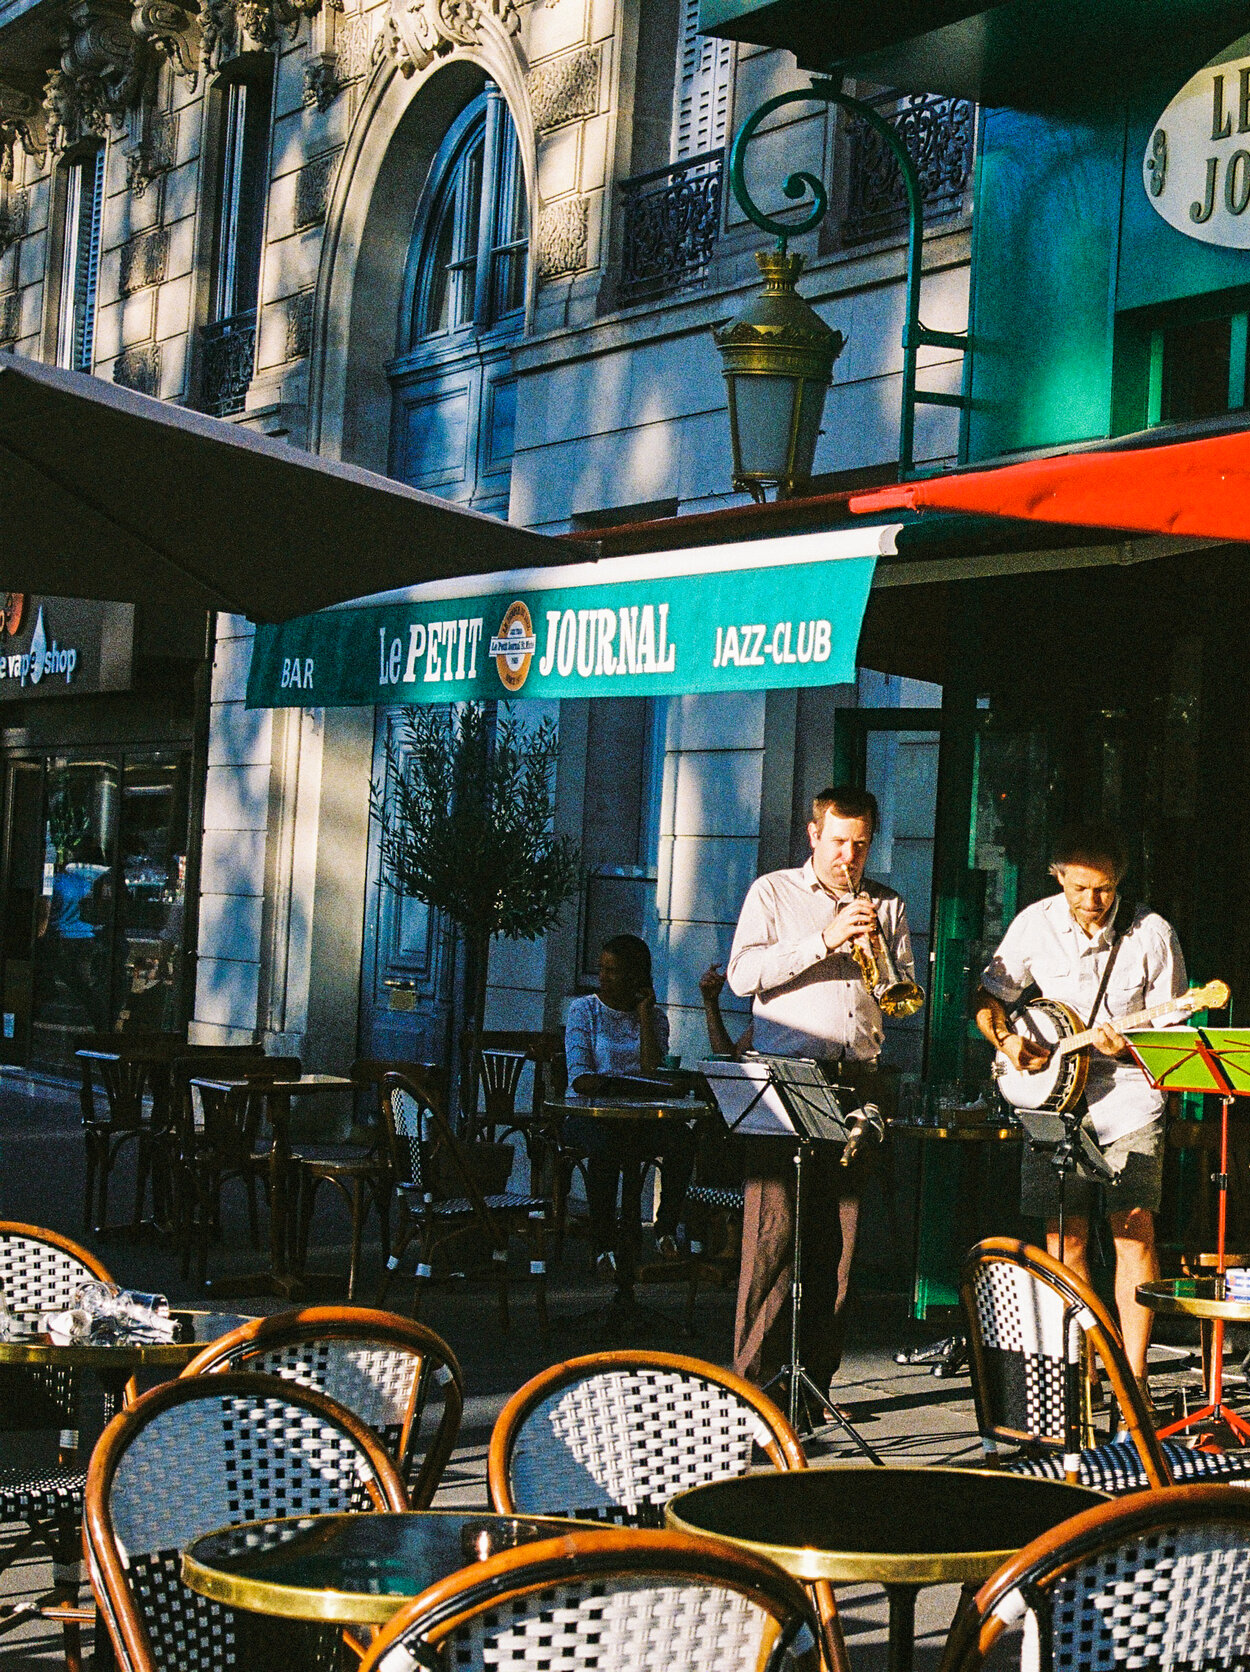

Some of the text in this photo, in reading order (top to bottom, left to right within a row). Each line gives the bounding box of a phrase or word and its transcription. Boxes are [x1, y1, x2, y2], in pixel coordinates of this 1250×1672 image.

[44, 640, 77, 684] shop
[402, 617, 484, 683] PETIT
[539, 602, 677, 678] JOURNAL
[712, 619, 833, 668] JAZZ-CLUB
[280, 657, 314, 689] BAR
